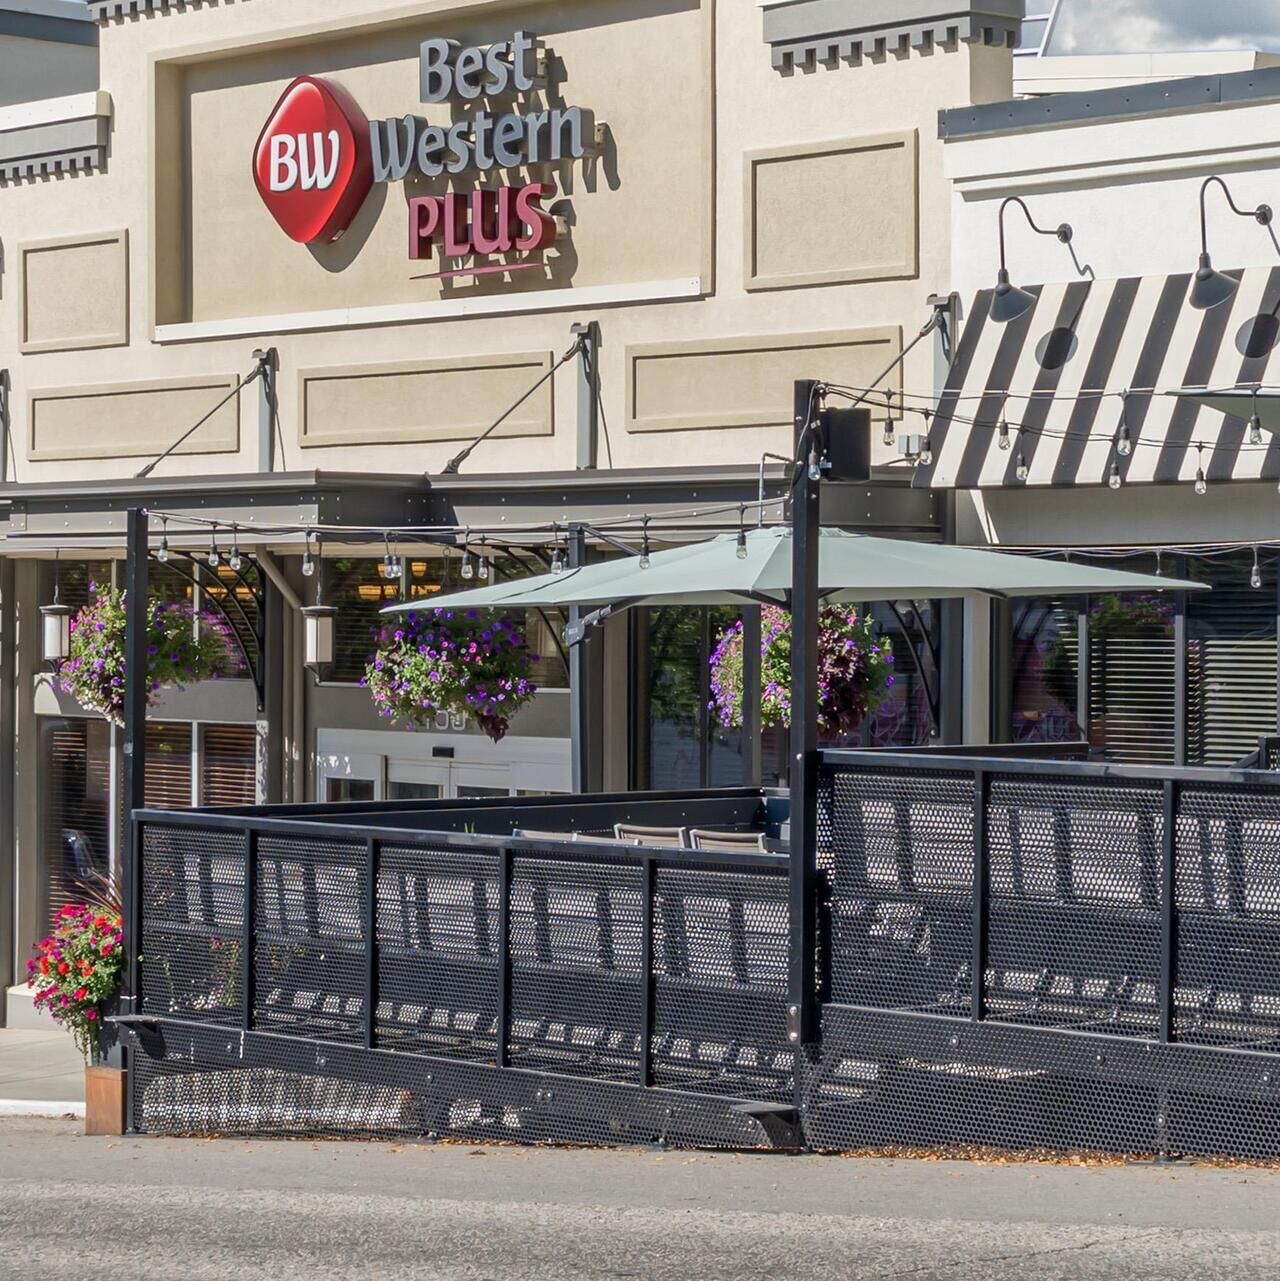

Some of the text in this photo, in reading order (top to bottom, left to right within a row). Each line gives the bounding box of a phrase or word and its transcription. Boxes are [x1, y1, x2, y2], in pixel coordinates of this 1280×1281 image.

[420, 31, 538, 103] Best
[269, 129, 340, 193] BW
[369, 106, 588, 183] Western
[409, 183, 548, 260] PLUS
